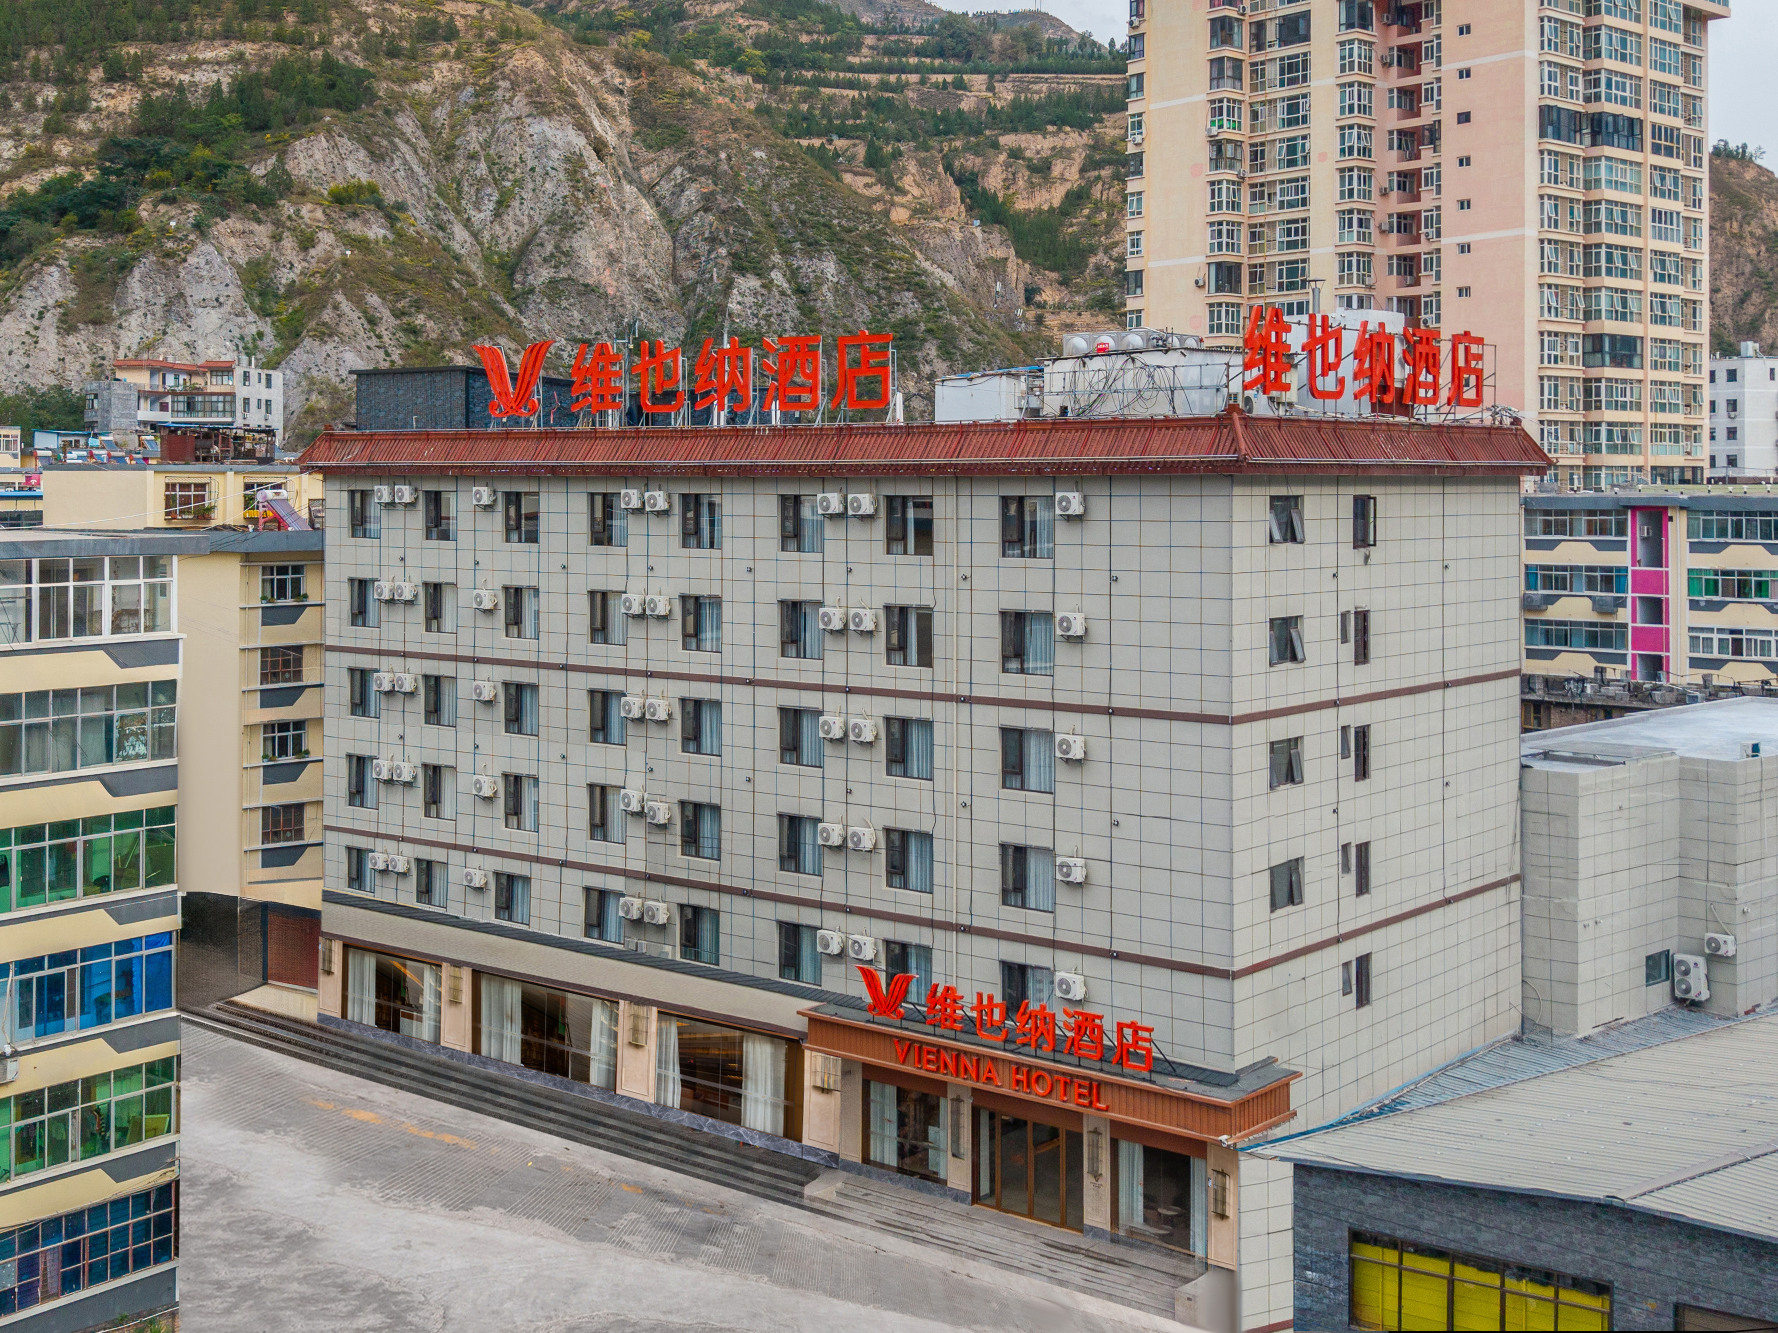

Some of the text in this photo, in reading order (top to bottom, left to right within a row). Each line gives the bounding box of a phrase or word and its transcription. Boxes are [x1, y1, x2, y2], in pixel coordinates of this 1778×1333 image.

[571, 330, 893, 414] 维也纳酒店
[1243, 305, 1484, 407] 维也纳酒店
[925, 983, 1154, 1072] 维也纳酒店
[894, 1039, 1109, 1111] VIENNA HOTEL
